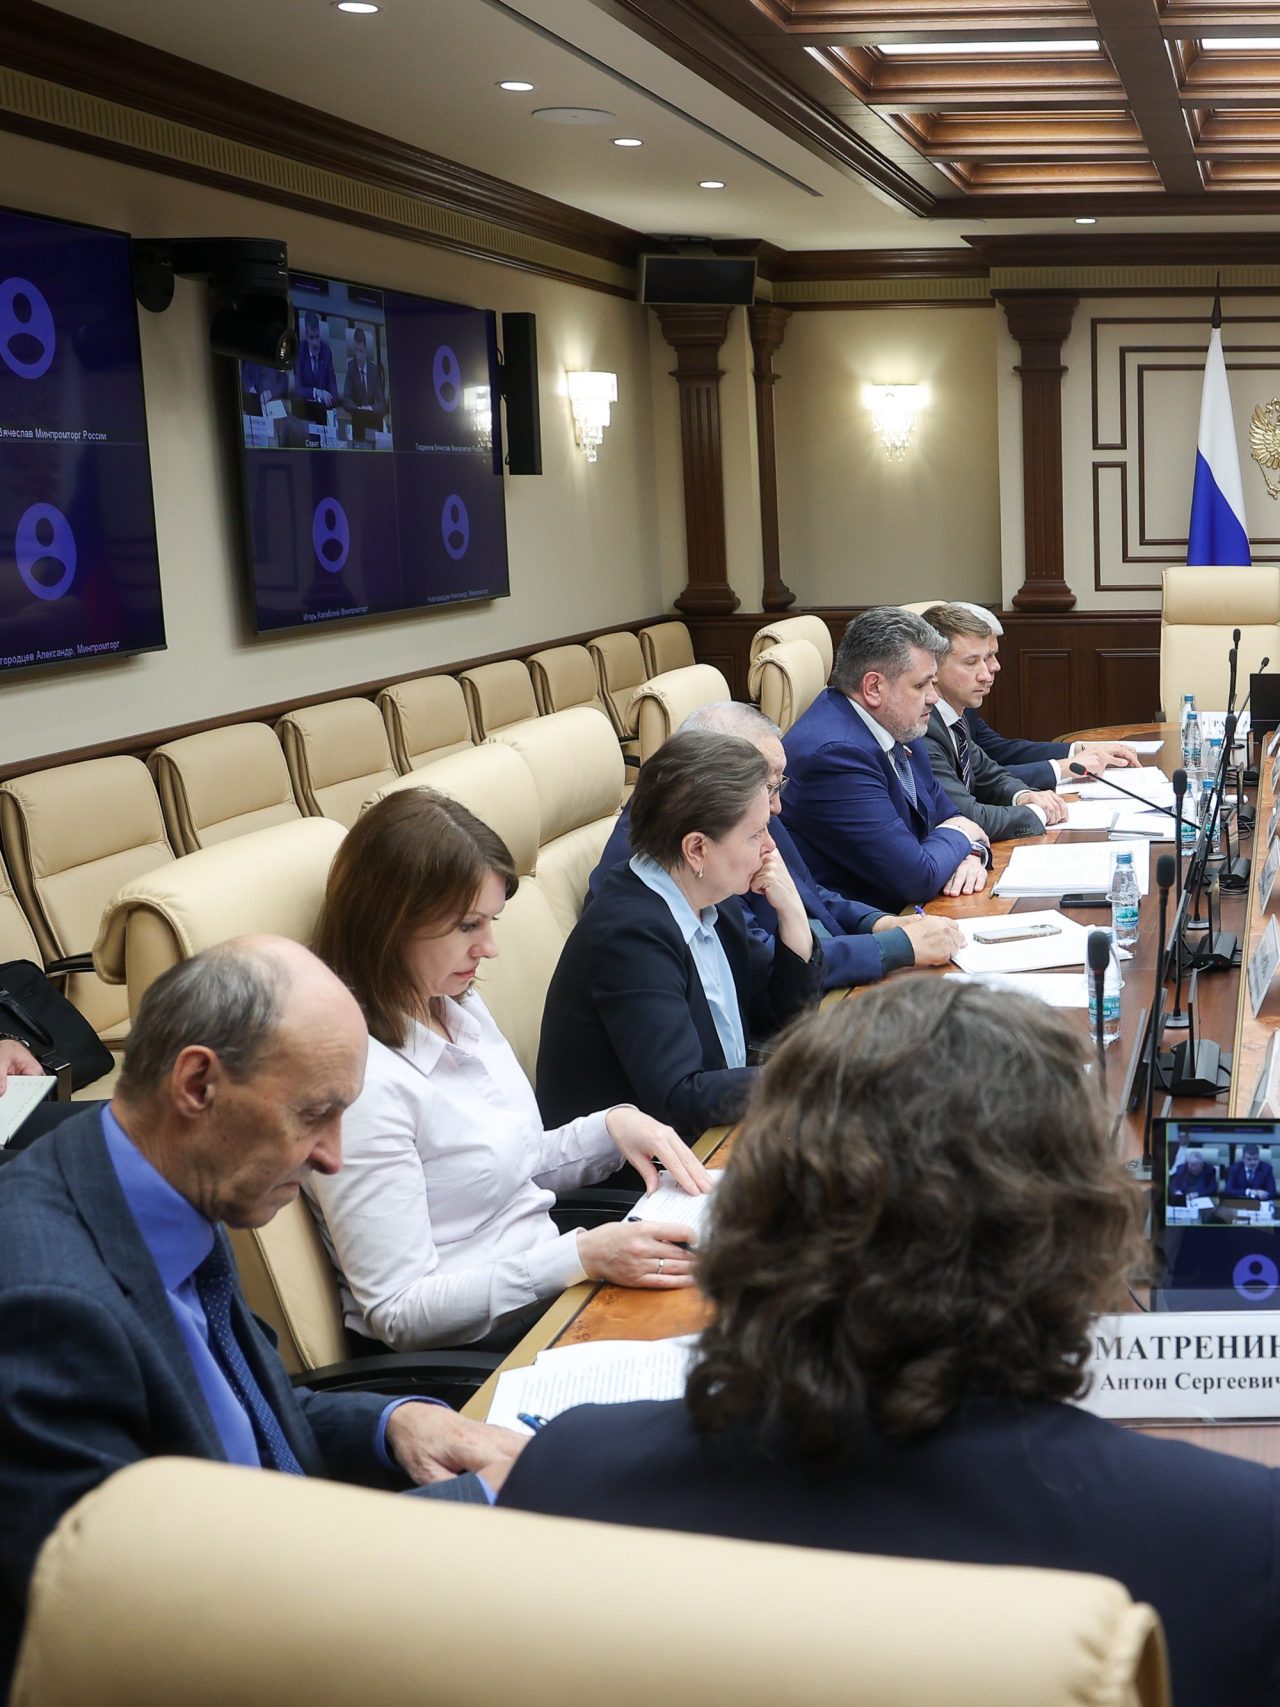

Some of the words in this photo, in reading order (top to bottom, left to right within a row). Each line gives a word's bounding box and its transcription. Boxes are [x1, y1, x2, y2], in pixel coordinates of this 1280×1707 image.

[35, 428, 81, 442] Минпромторг
[83, 430, 107, 440] России
[0, 652, 35, 667] городцев
[77, 641, 120, 654] Минпромторг
[1100, 1373, 1167, 1391] Антон
